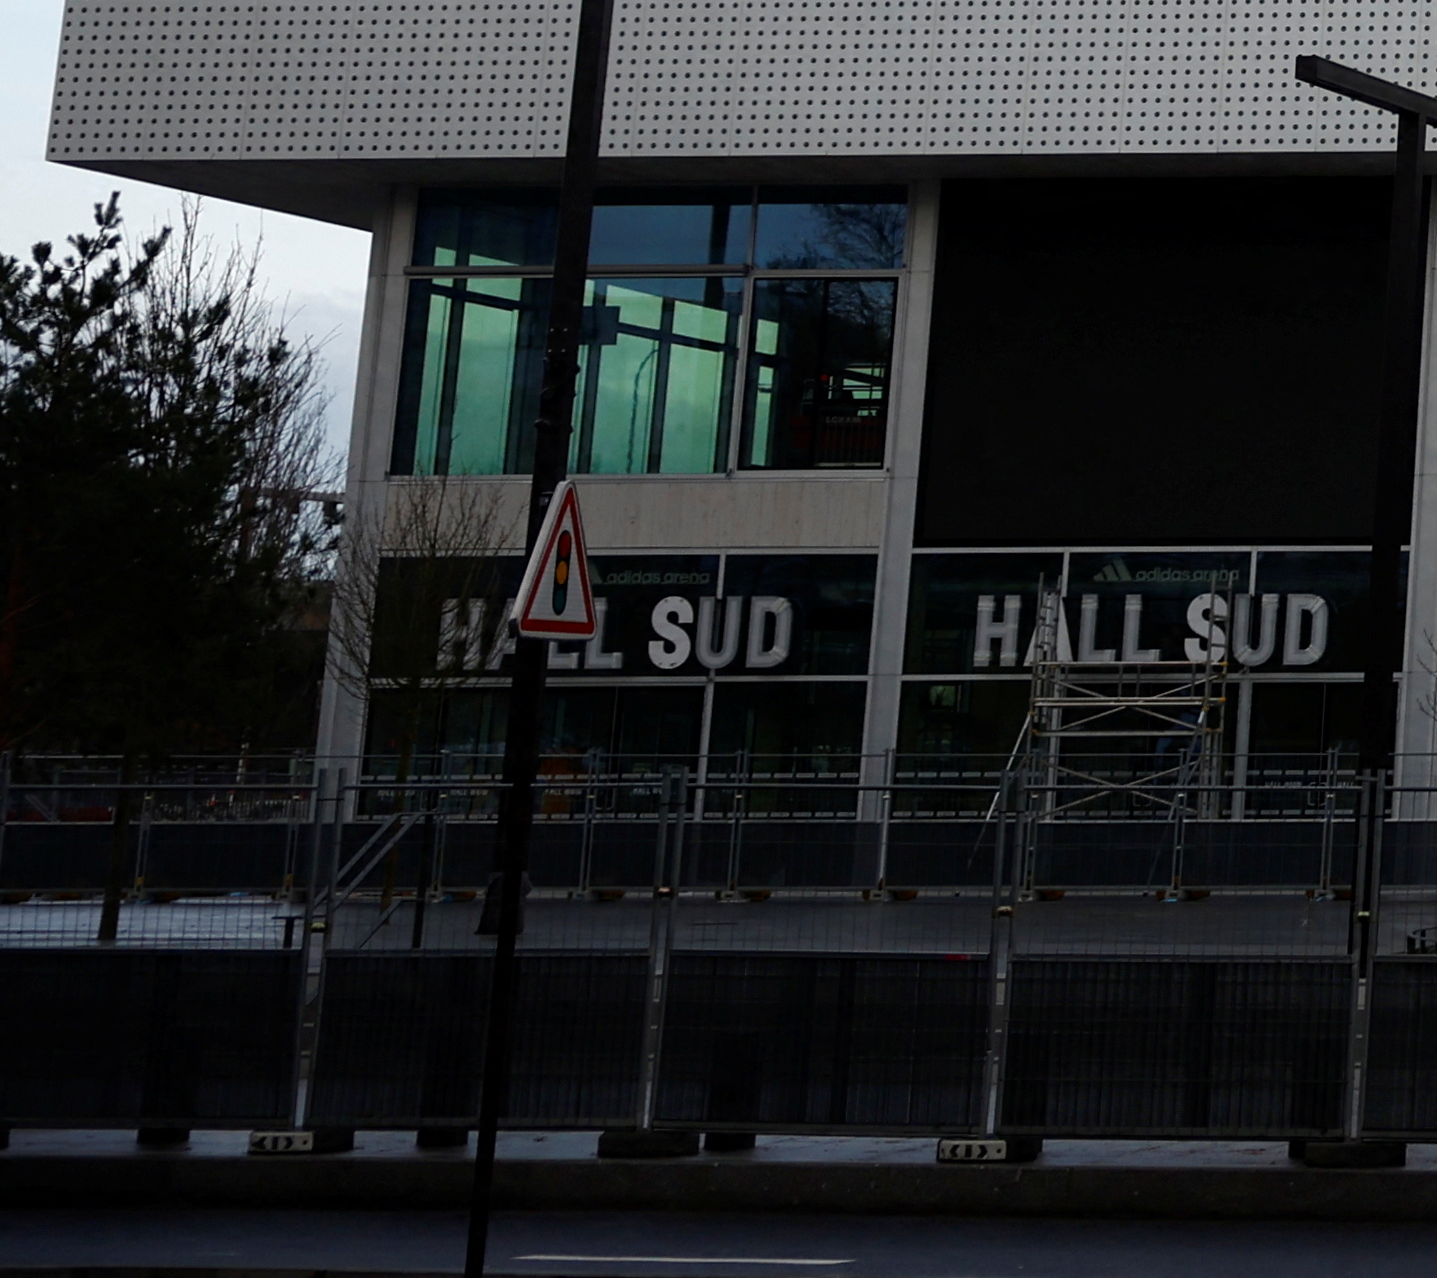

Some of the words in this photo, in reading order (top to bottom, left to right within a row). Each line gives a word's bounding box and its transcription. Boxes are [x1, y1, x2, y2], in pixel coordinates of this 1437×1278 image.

[606, 570, 661, 585] adidas
[663, 572, 710, 585] arena
[1135, 567, 1190, 582] adidas
[648, 595, 793, 670] SUD
[1184, 593, 1330, 667] SUD
